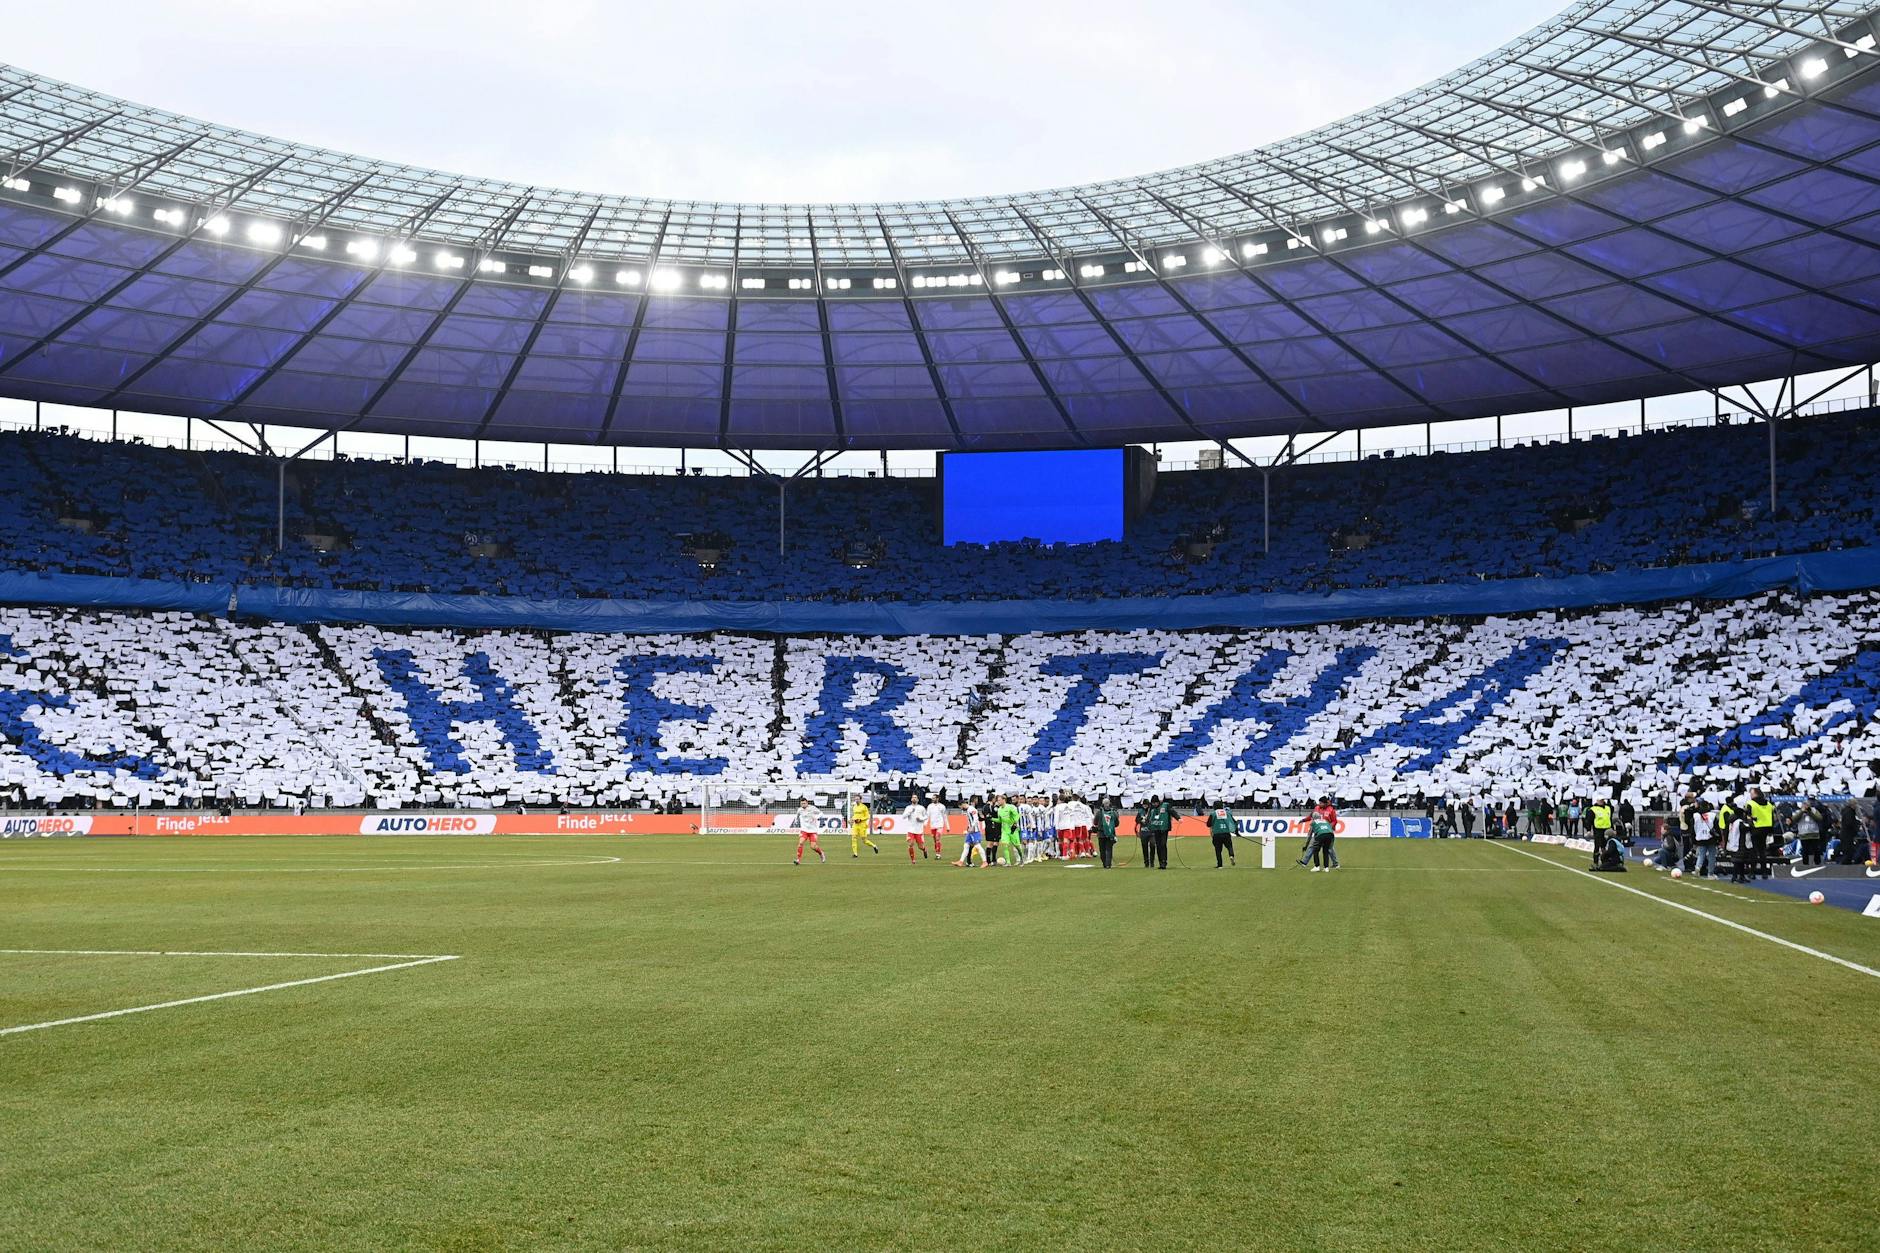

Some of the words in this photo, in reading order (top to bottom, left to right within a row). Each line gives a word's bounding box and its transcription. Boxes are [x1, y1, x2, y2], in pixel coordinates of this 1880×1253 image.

[371, 636, 1571, 776] HERTHA
[4, 819, 75, 833] AUTOHERO
[156, 816, 196, 831] Finde
[376, 817, 478, 832] AUTOHERO
[557, 815, 598, 830] Finde
